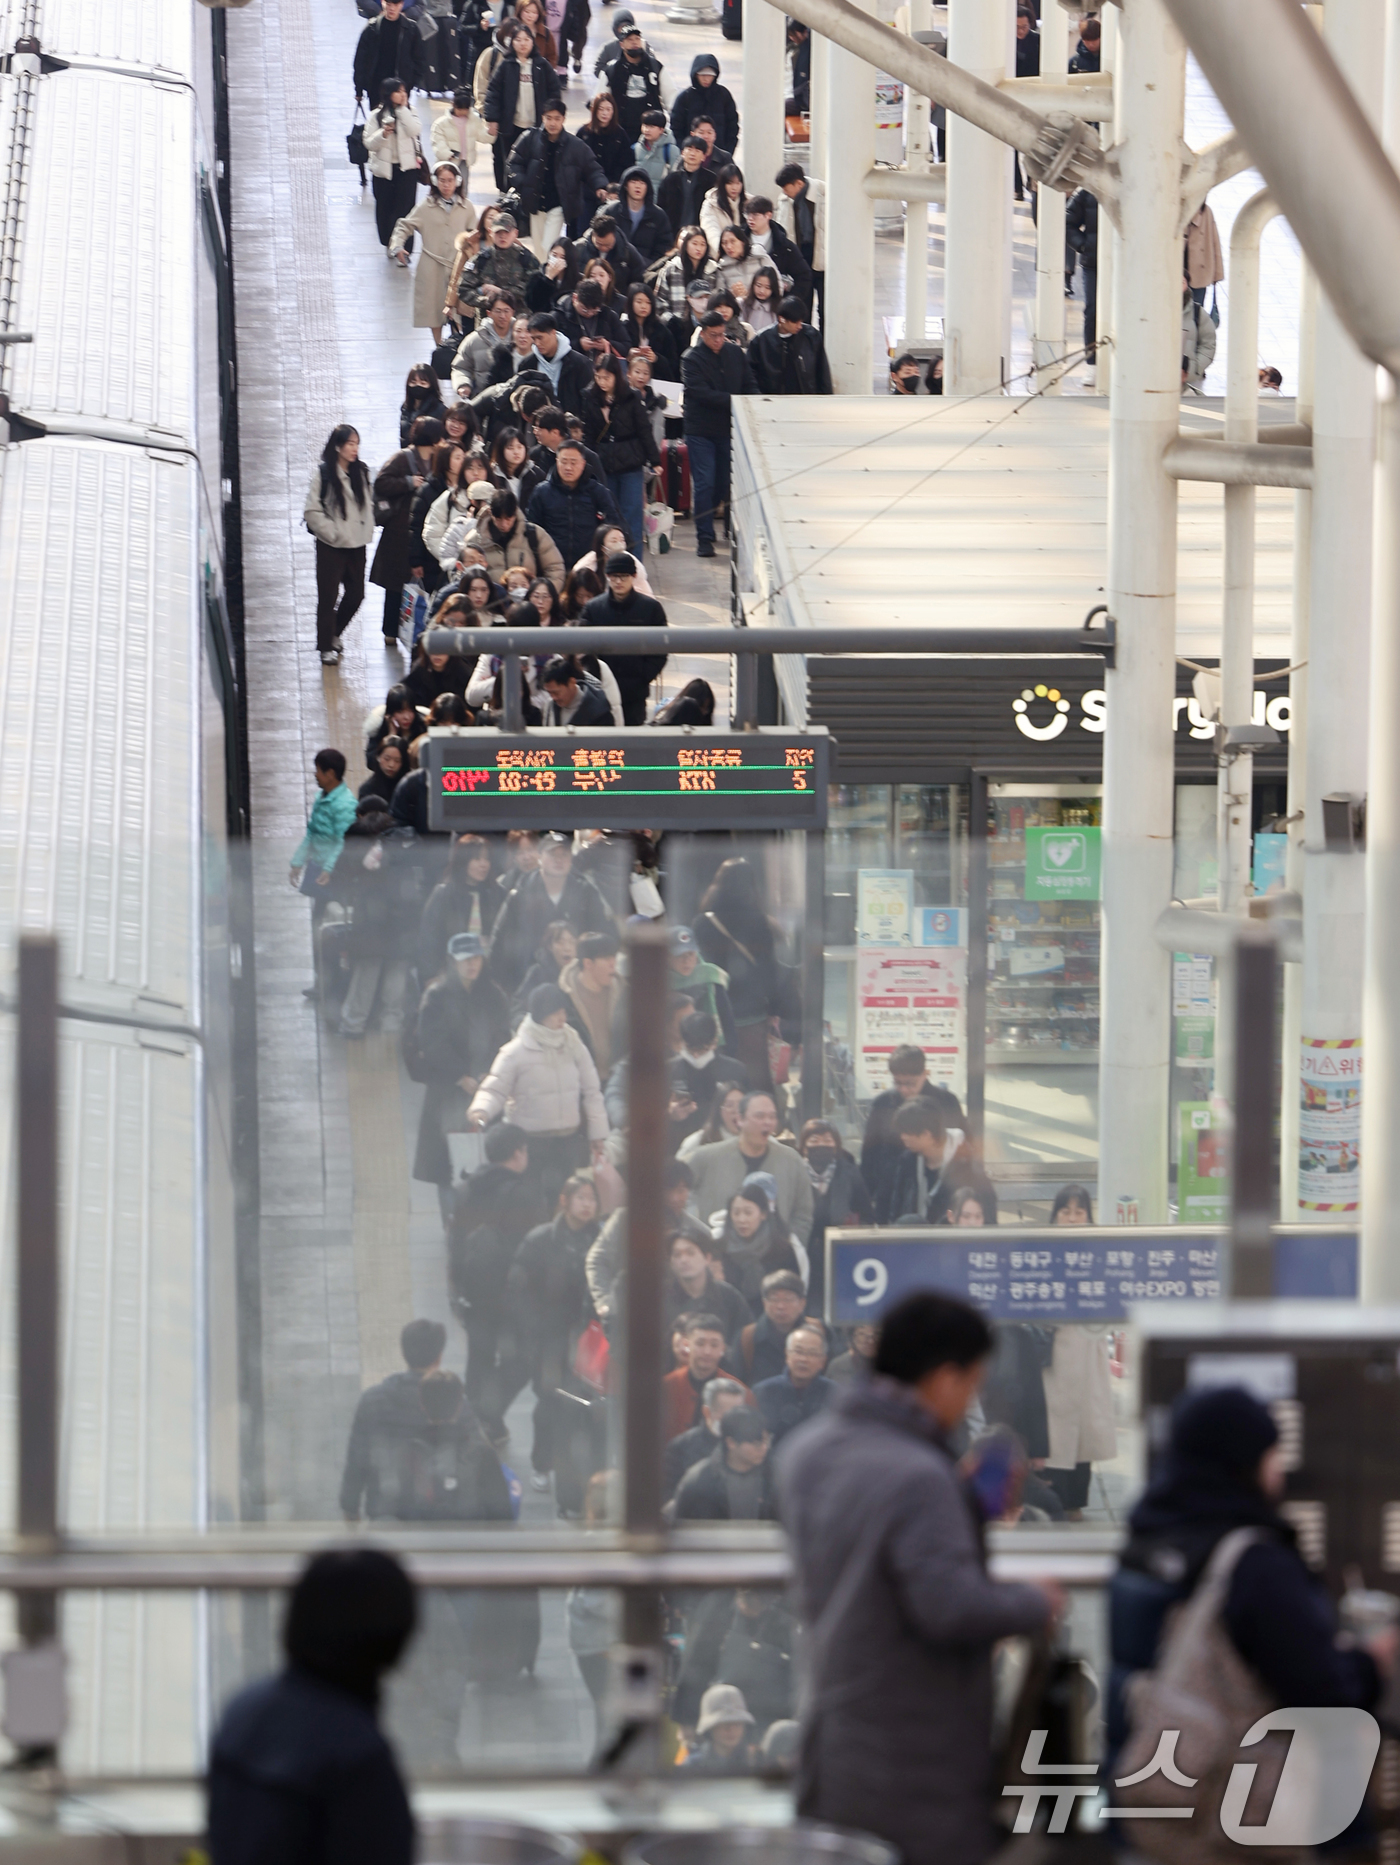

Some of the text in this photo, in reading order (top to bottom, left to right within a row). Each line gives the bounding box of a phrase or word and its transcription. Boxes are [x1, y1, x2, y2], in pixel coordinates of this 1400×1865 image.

[791, 769, 807, 790] 5
[968, 1251, 998, 1269] 대전
[1009, 1250, 1052, 1269] 동대구
[1064, 1250, 1094, 1268] 부산
[1106, 1250, 1135, 1268] 포항
[1147, 1249, 1176, 1267] 진주
[852, 1257, 889, 1307] 9
[1009, 1281, 1067, 1300] 광주송정
